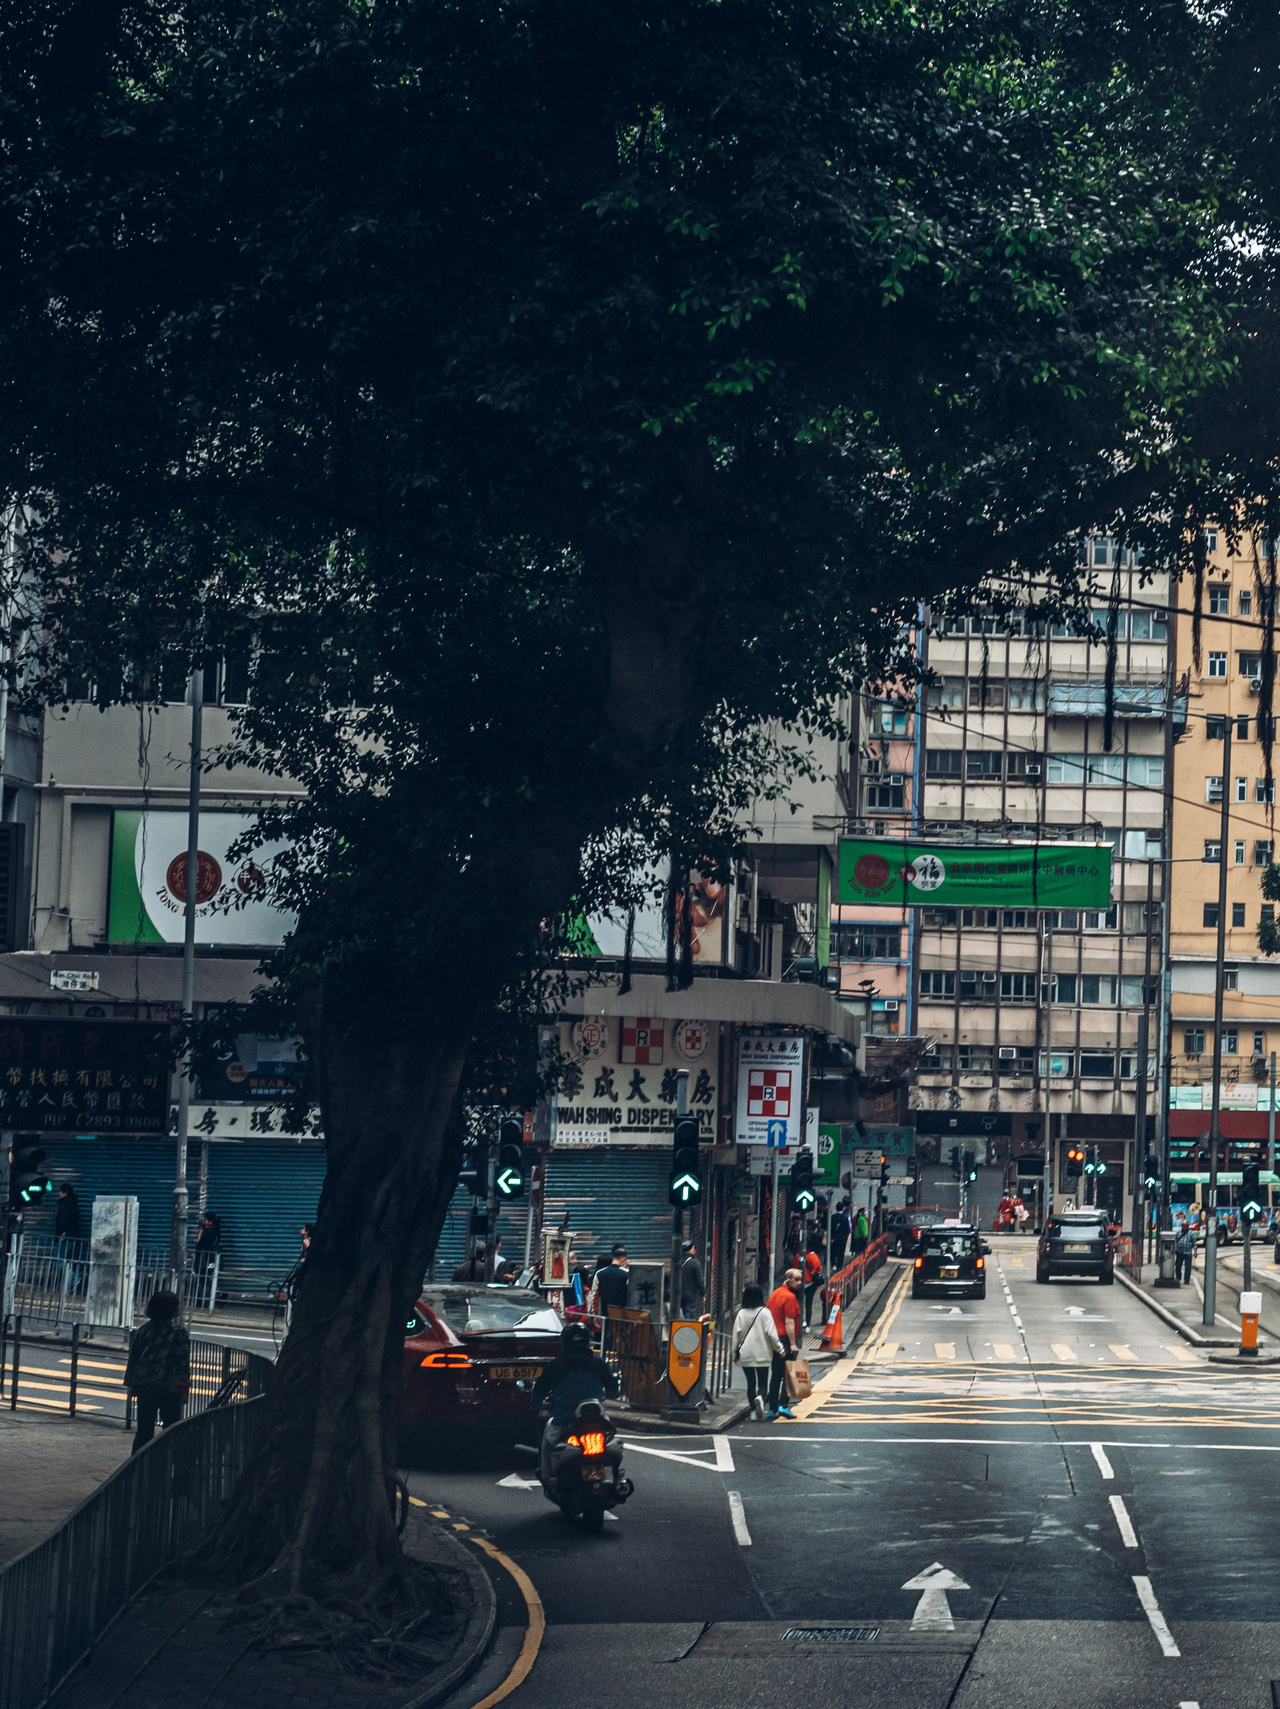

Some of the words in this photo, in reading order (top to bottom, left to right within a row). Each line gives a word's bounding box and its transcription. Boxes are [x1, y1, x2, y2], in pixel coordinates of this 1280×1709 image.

[156, 886, 179, 913] TONG
[558, 1106, 584, 1124] WAH
[586, 1107, 622, 1125] SHING
[627, 1108, 715, 1126] DISPENARY
[495, 1368, 510, 1378] US
[513, 1368, 537, 1379] 6517
